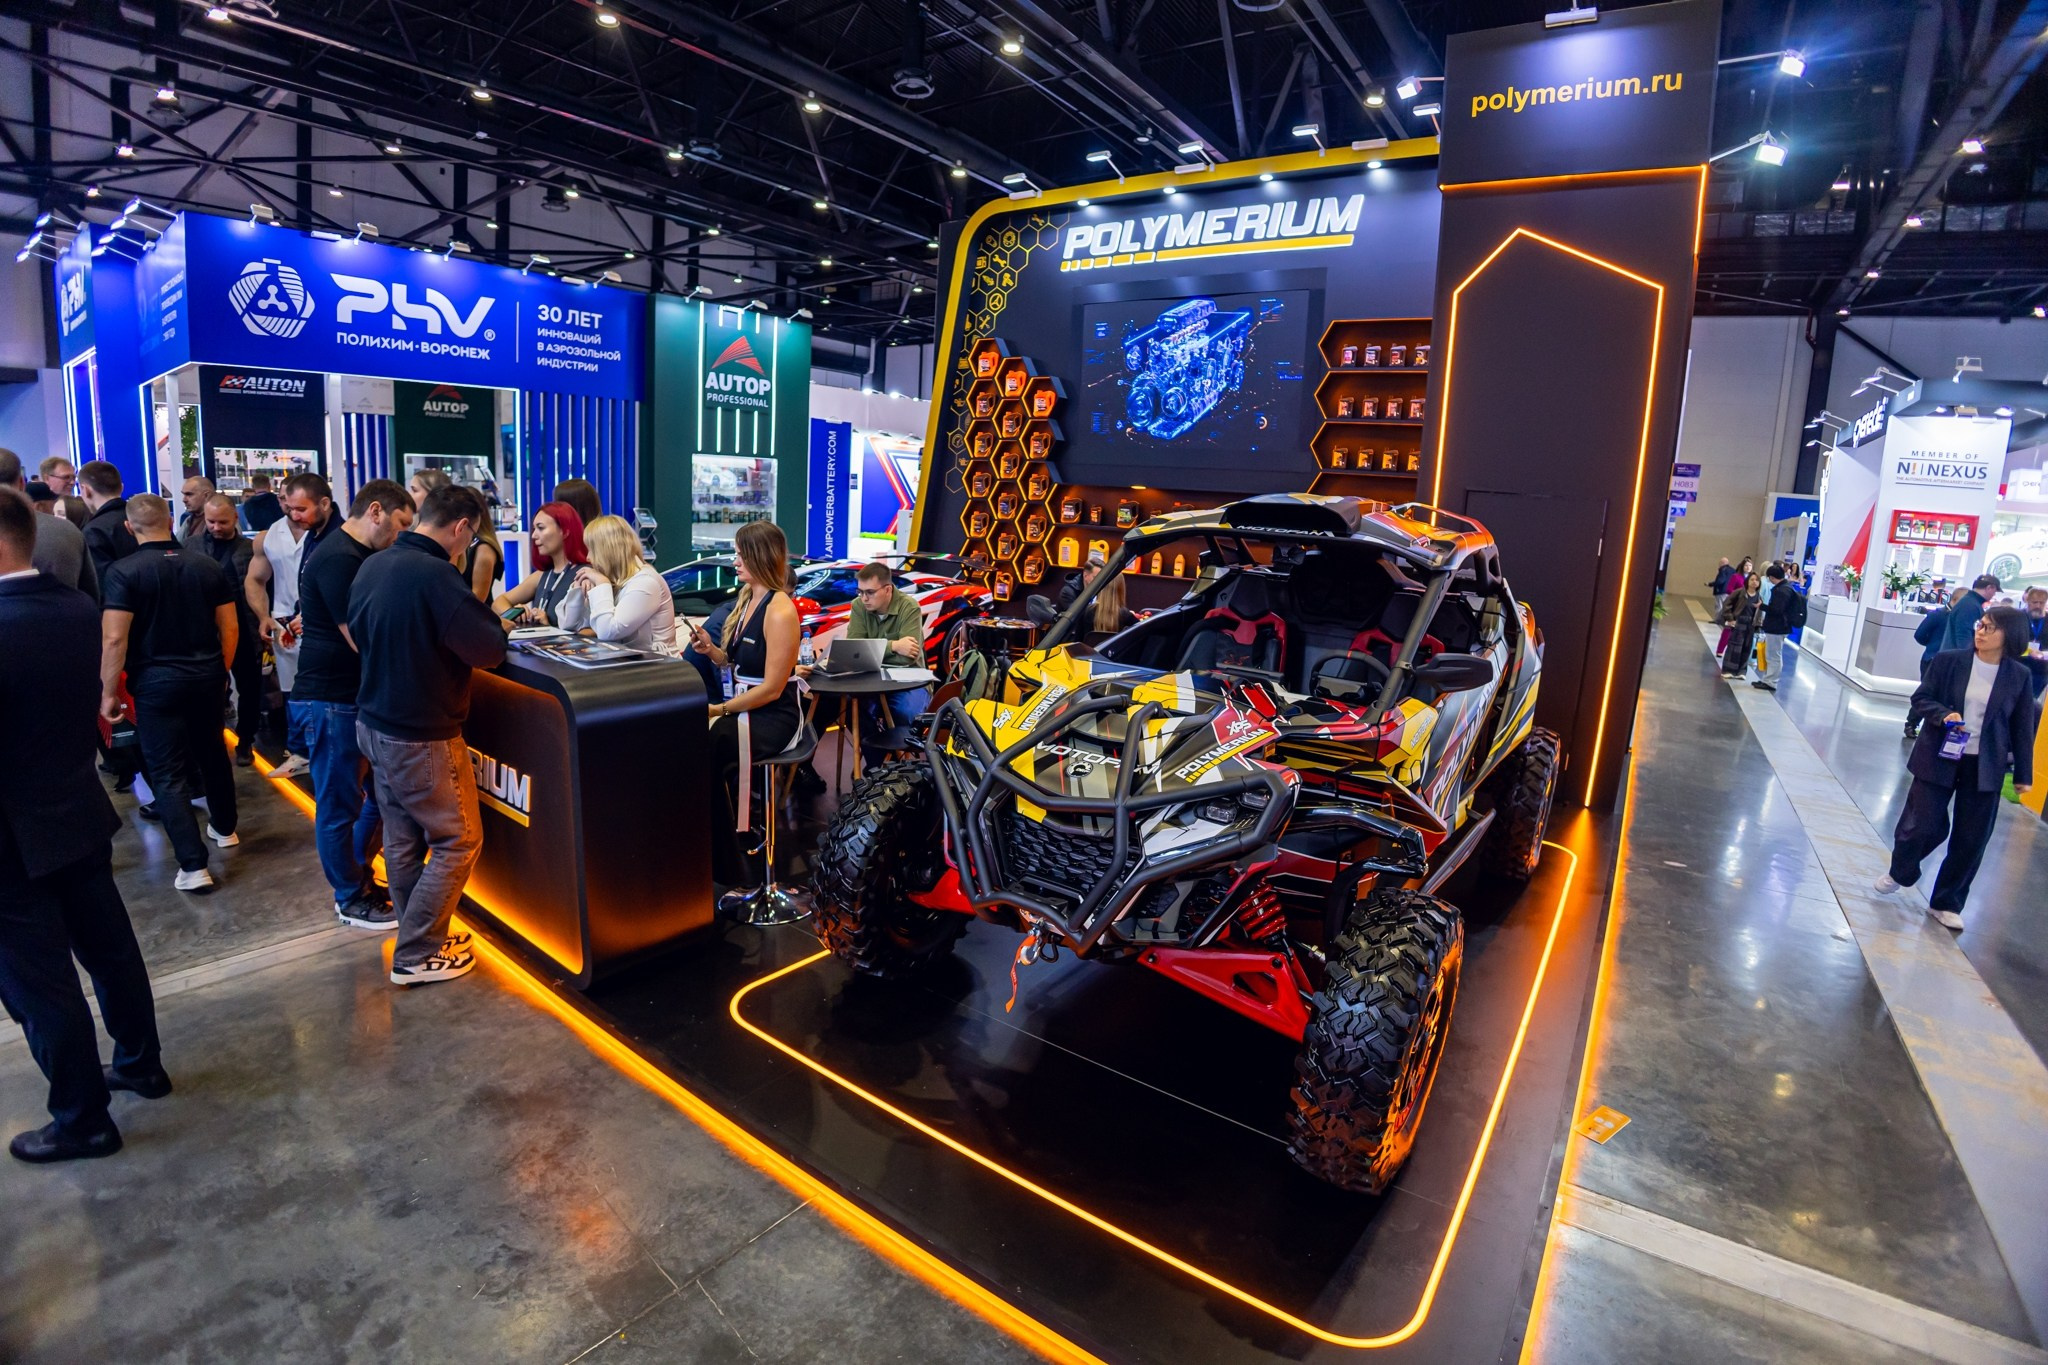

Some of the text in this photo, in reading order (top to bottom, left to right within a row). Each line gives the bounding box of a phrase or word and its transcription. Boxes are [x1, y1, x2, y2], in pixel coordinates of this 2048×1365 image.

[1471, 72, 1683, 118] polymerium.ru
[1063, 194, 1365, 260] POLYMERIUM
[330, 273, 496, 338] PHV
[538, 304, 603, 329] 30 ЛЕТ
[537, 327, 602, 345] ИННОВАЦИЙ
[537, 342, 622, 362] В АЭРОЗОЛЬНОЙ
[537, 356, 599, 373] ИНДУСТРИИ
[243, 376, 307, 392] AUTON
[705, 371, 771, 396] AUTOP
[423, 400, 470, 413] AUTOP
[706, 392, 769, 408] PROFESSIONAL
[1911, 450, 1958, 459] MEMBER
[1927, 463, 1988, 480] NEXUS
[1237, 525, 1324, 536] MOTOFAN
[1019, 685, 1068, 731] POLYMERIUM
[1226, 720, 1252, 736] XPS
[1175, 728, 1269, 780] POLYMERIUM
